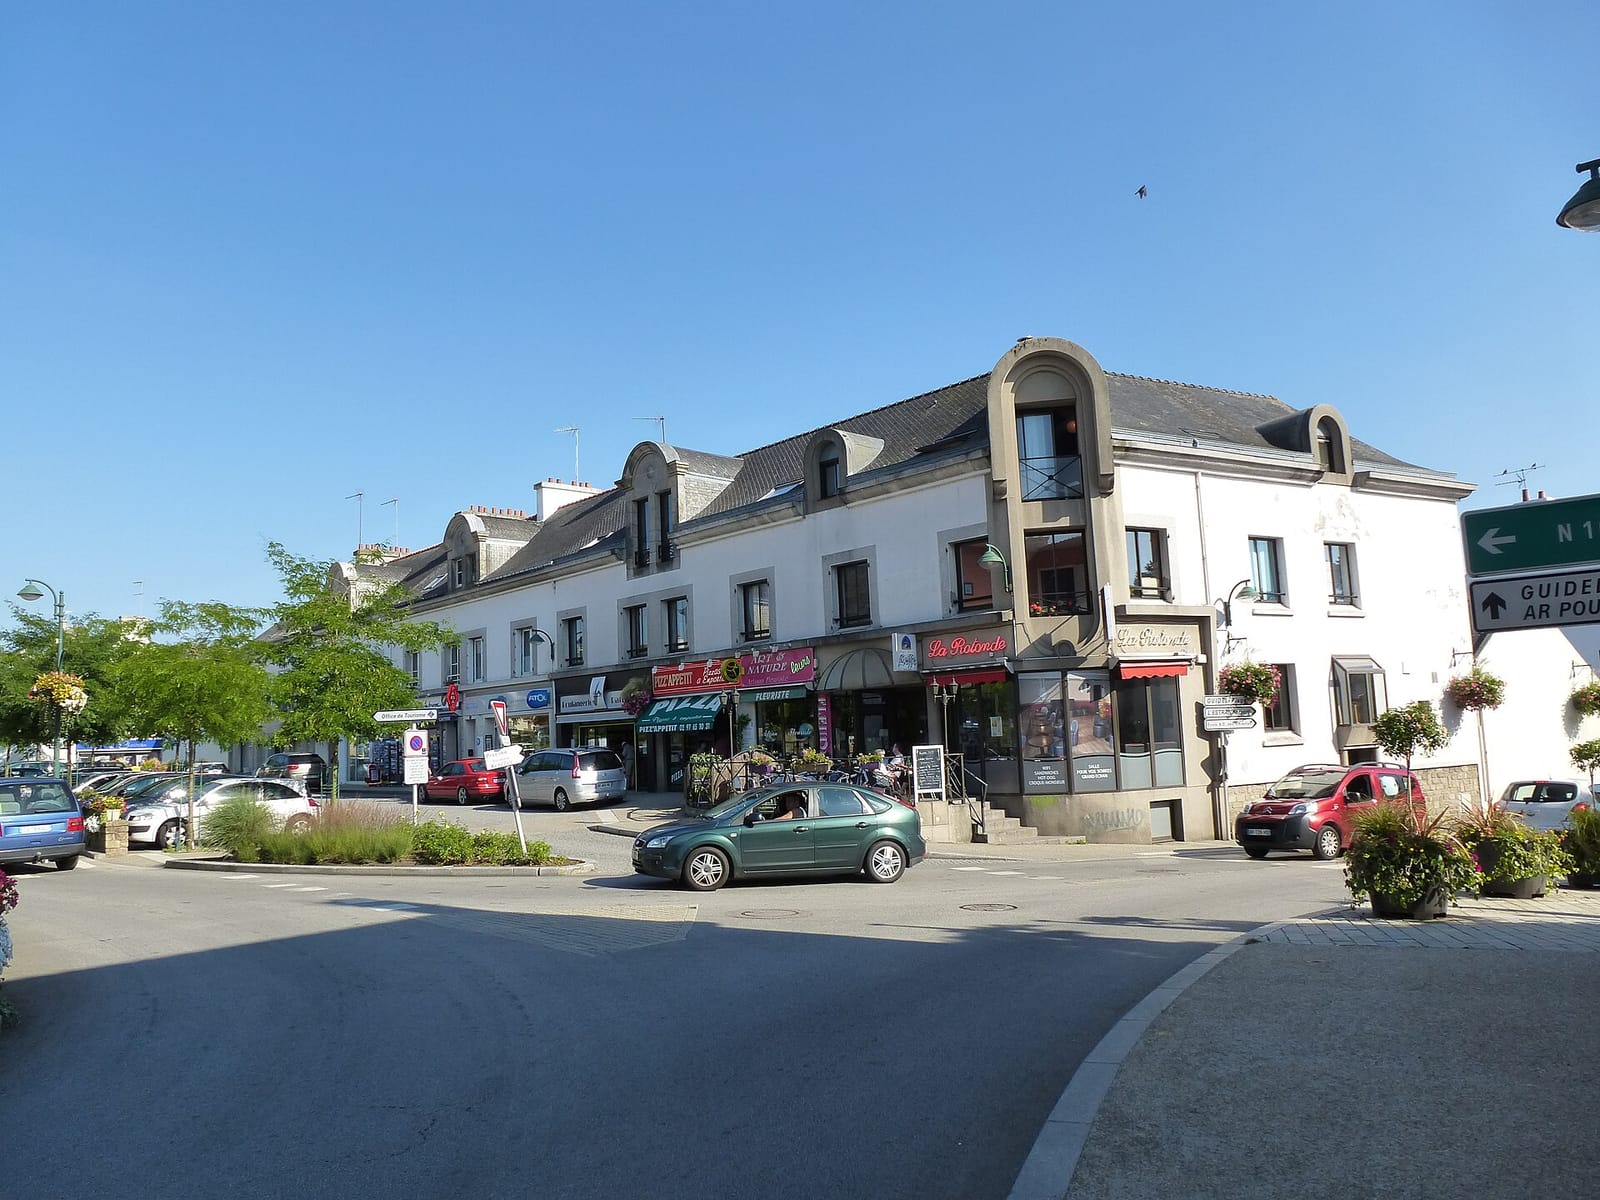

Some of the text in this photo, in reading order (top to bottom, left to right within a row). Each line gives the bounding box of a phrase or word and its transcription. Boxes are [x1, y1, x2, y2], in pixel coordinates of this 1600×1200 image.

[1557, 520, 1600, 542] N 1
[1523, 599, 1600, 620] AR POU
[928, 635, 1007, 658] La Rotonde
[1117, 627, 1191, 647] La Rotonde
[748, 662, 787, 675] NATURE
[751, 653, 773, 664] ART
[649, 694, 721, 716] PIZZA
[756, 690, 790, 701] FLEURISTE
